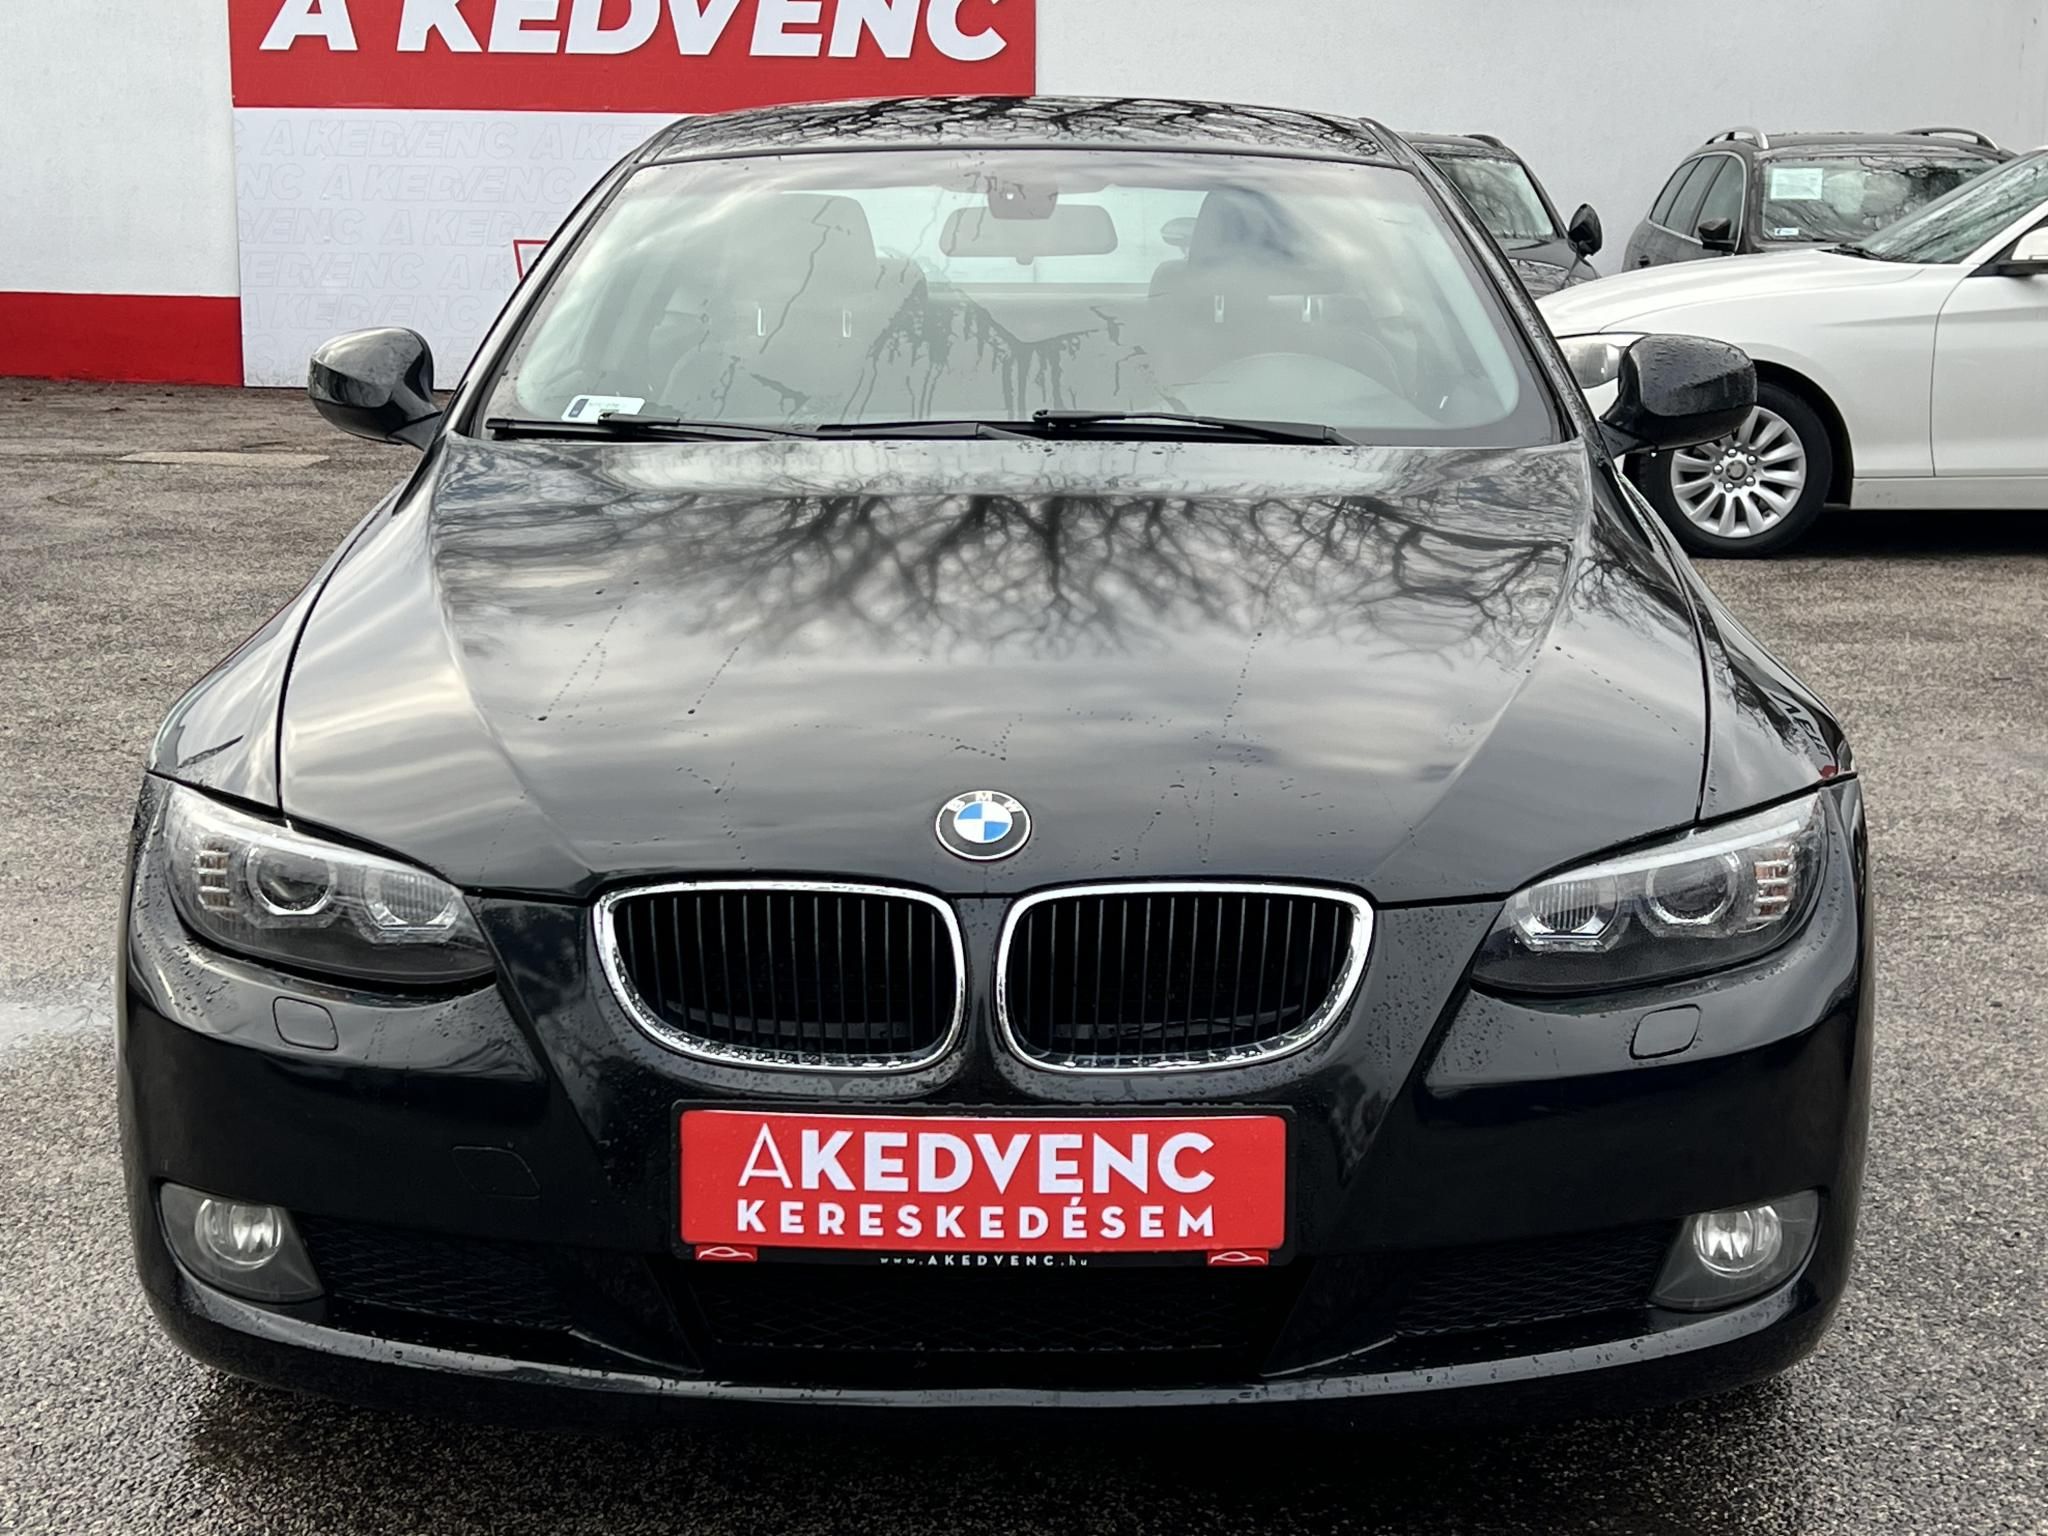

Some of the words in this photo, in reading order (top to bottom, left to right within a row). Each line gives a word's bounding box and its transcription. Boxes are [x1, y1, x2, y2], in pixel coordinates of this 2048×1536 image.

[260, 0, 358, 51] A
[397, 0, 1008, 62] KEDVENC
[736, 1195, 1214, 1240] KERESKEDÉSEM
[879, 1254, 1088, 1267] www.AKEDVENC.hu
